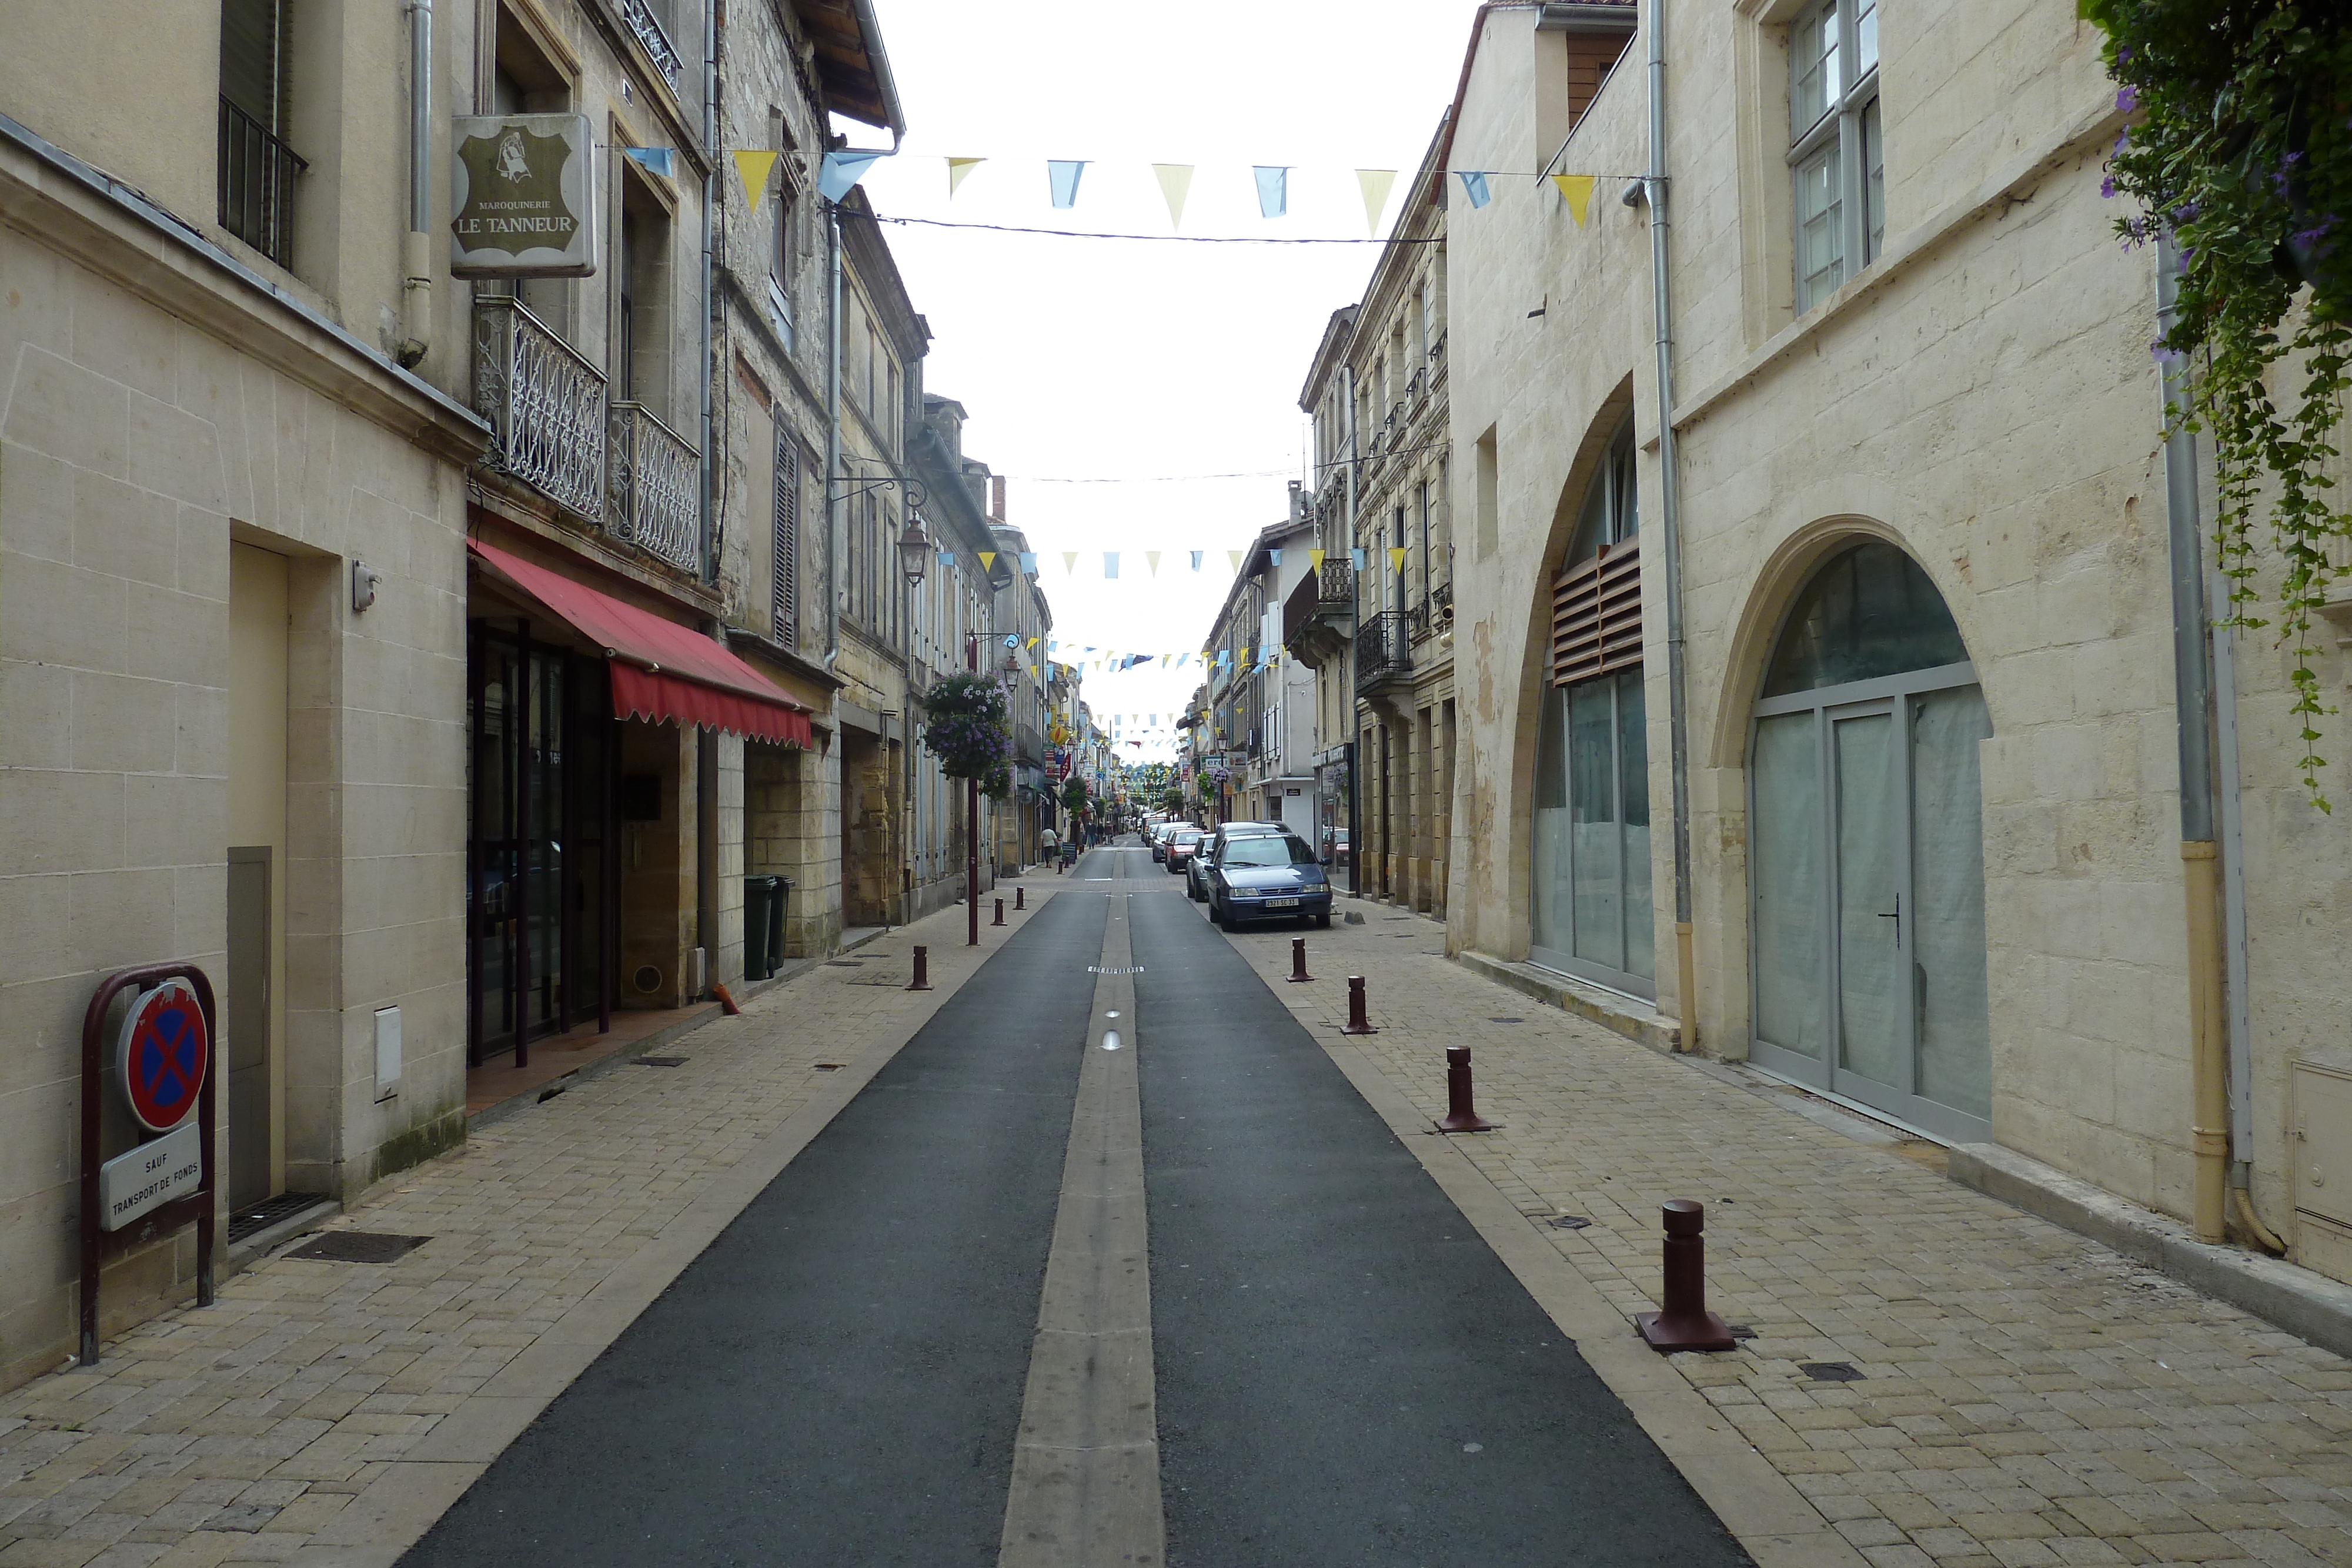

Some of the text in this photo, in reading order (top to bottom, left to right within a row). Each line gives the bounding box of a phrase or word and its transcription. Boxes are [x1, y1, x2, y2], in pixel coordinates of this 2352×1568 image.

[479, 200, 550, 210] MAROQUINERIE
[459, 216, 572, 233] LE TANNEUR
[146, 1154, 167, 1173] SAUF
[113, 1162, 198, 1216] TRANSPORT DE FONDS
